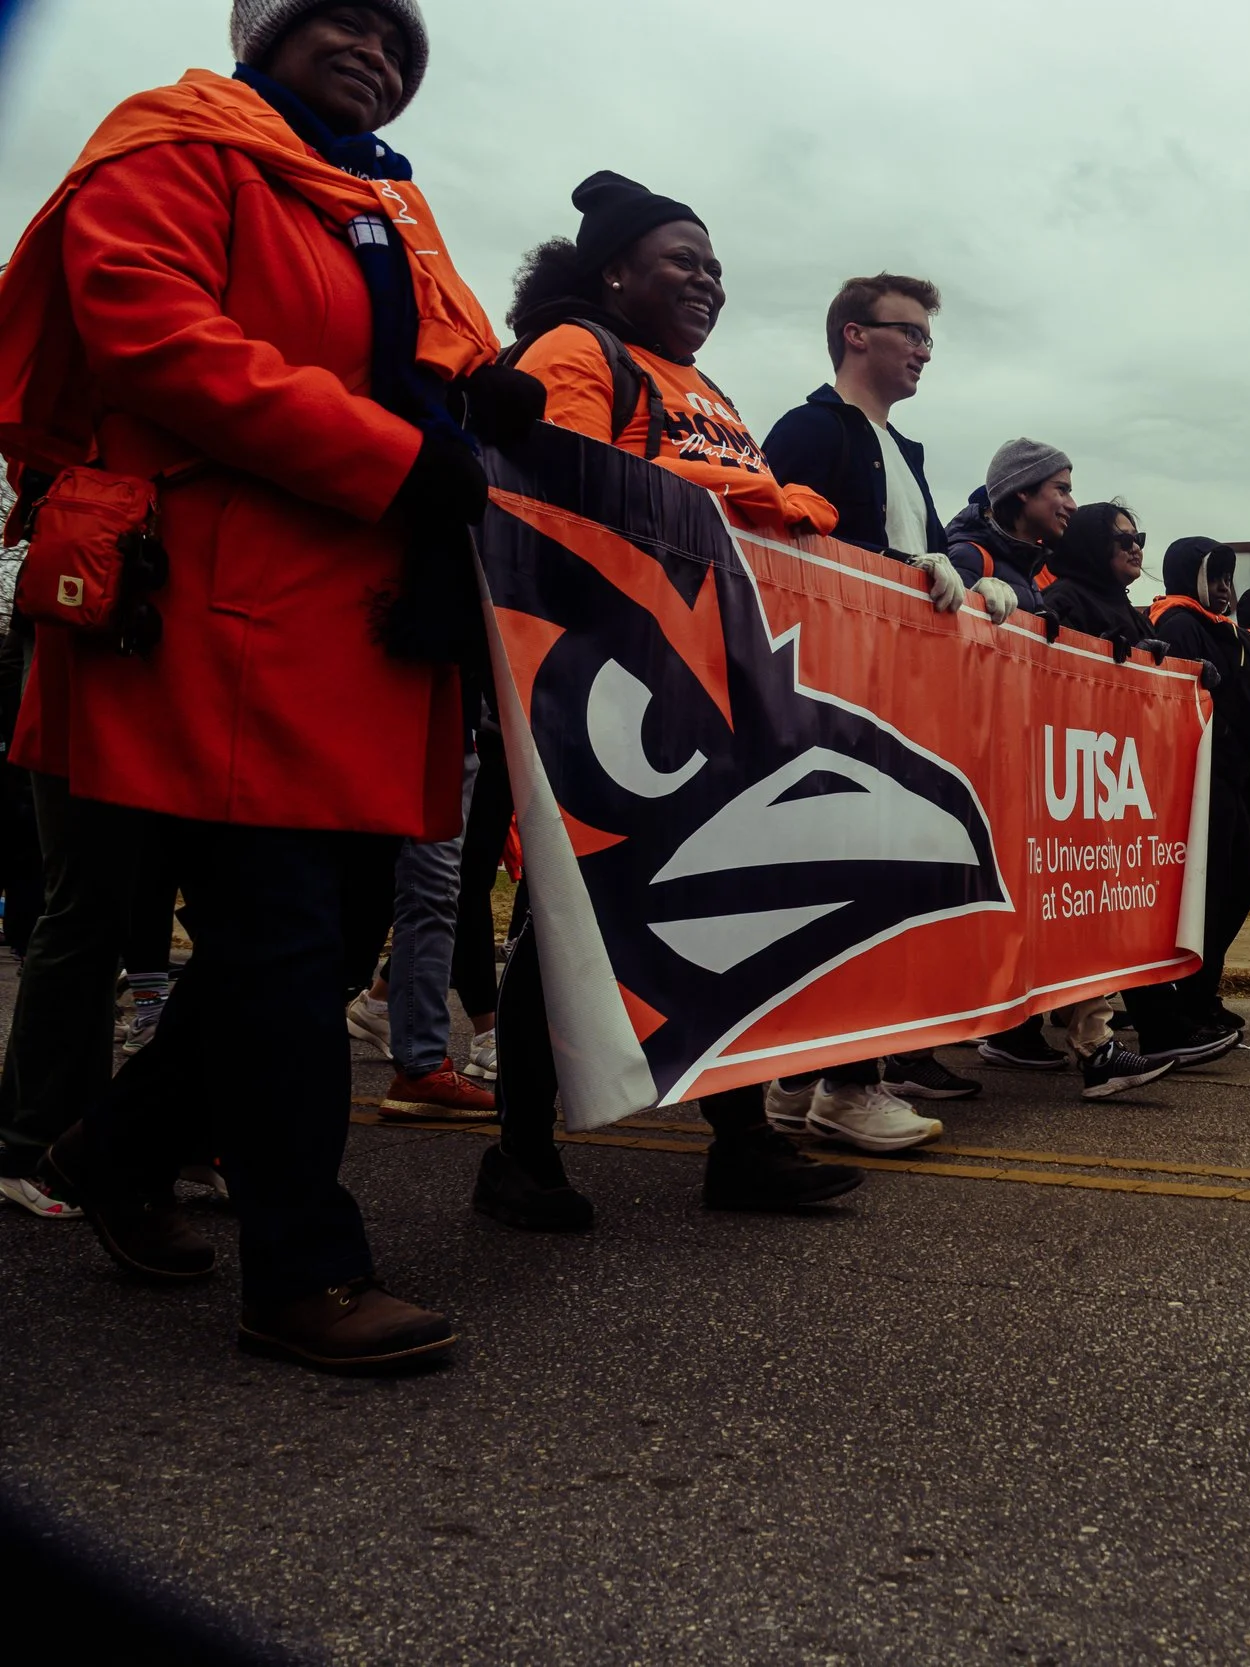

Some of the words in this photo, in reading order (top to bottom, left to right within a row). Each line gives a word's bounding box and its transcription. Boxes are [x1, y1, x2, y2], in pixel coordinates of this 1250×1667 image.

[1044, 724, 1153, 822] UTSA
[1047, 837, 1122, 877] University
[1126, 836, 1143, 868] of
[1148, 836, 1187, 867] Texa
[1042, 886, 1057, 921] at
[1061, 882, 1094, 918] San
[1099, 877, 1156, 913] Antonio
